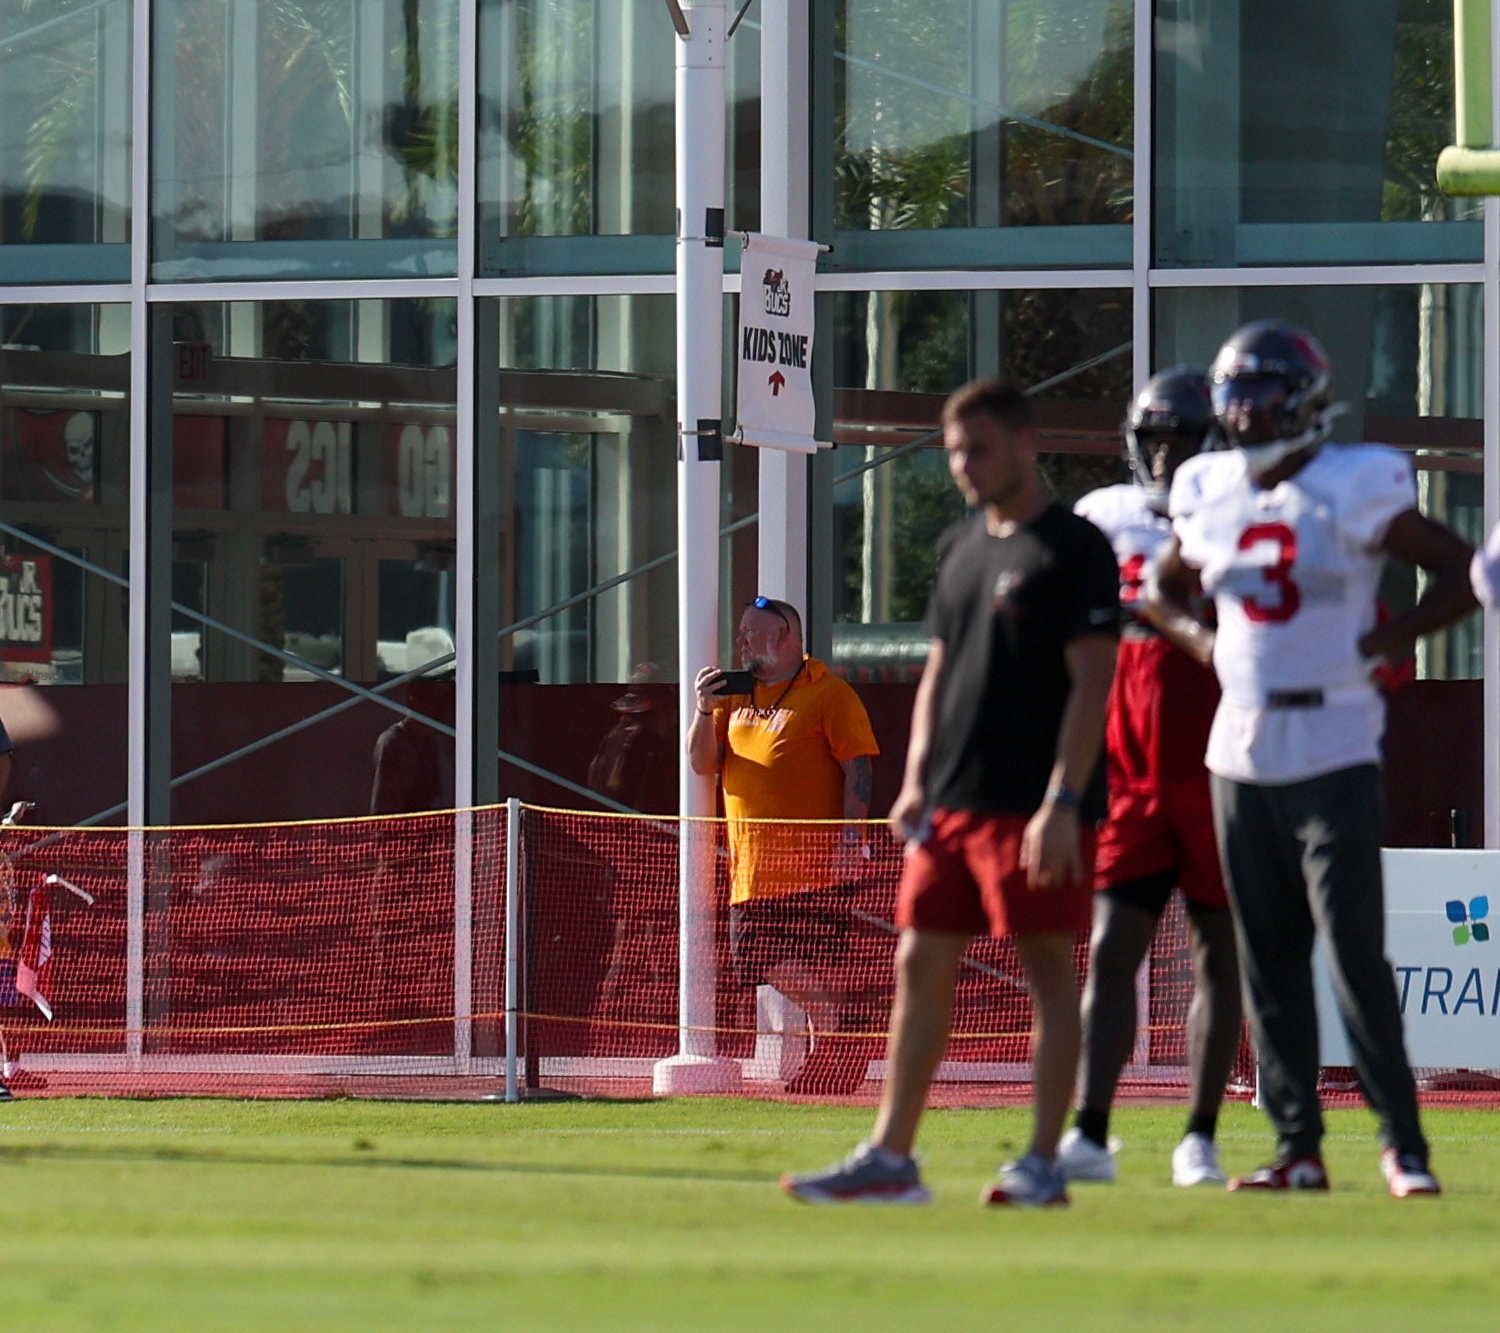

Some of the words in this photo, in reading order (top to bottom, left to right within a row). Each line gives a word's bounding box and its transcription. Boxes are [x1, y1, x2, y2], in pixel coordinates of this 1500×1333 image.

[764, 284, 789, 314] BUCS
[743, 326, 776, 364] KIDS
[778, 332, 809, 368] ZONE
[1237, 522, 1300, 623] 3
